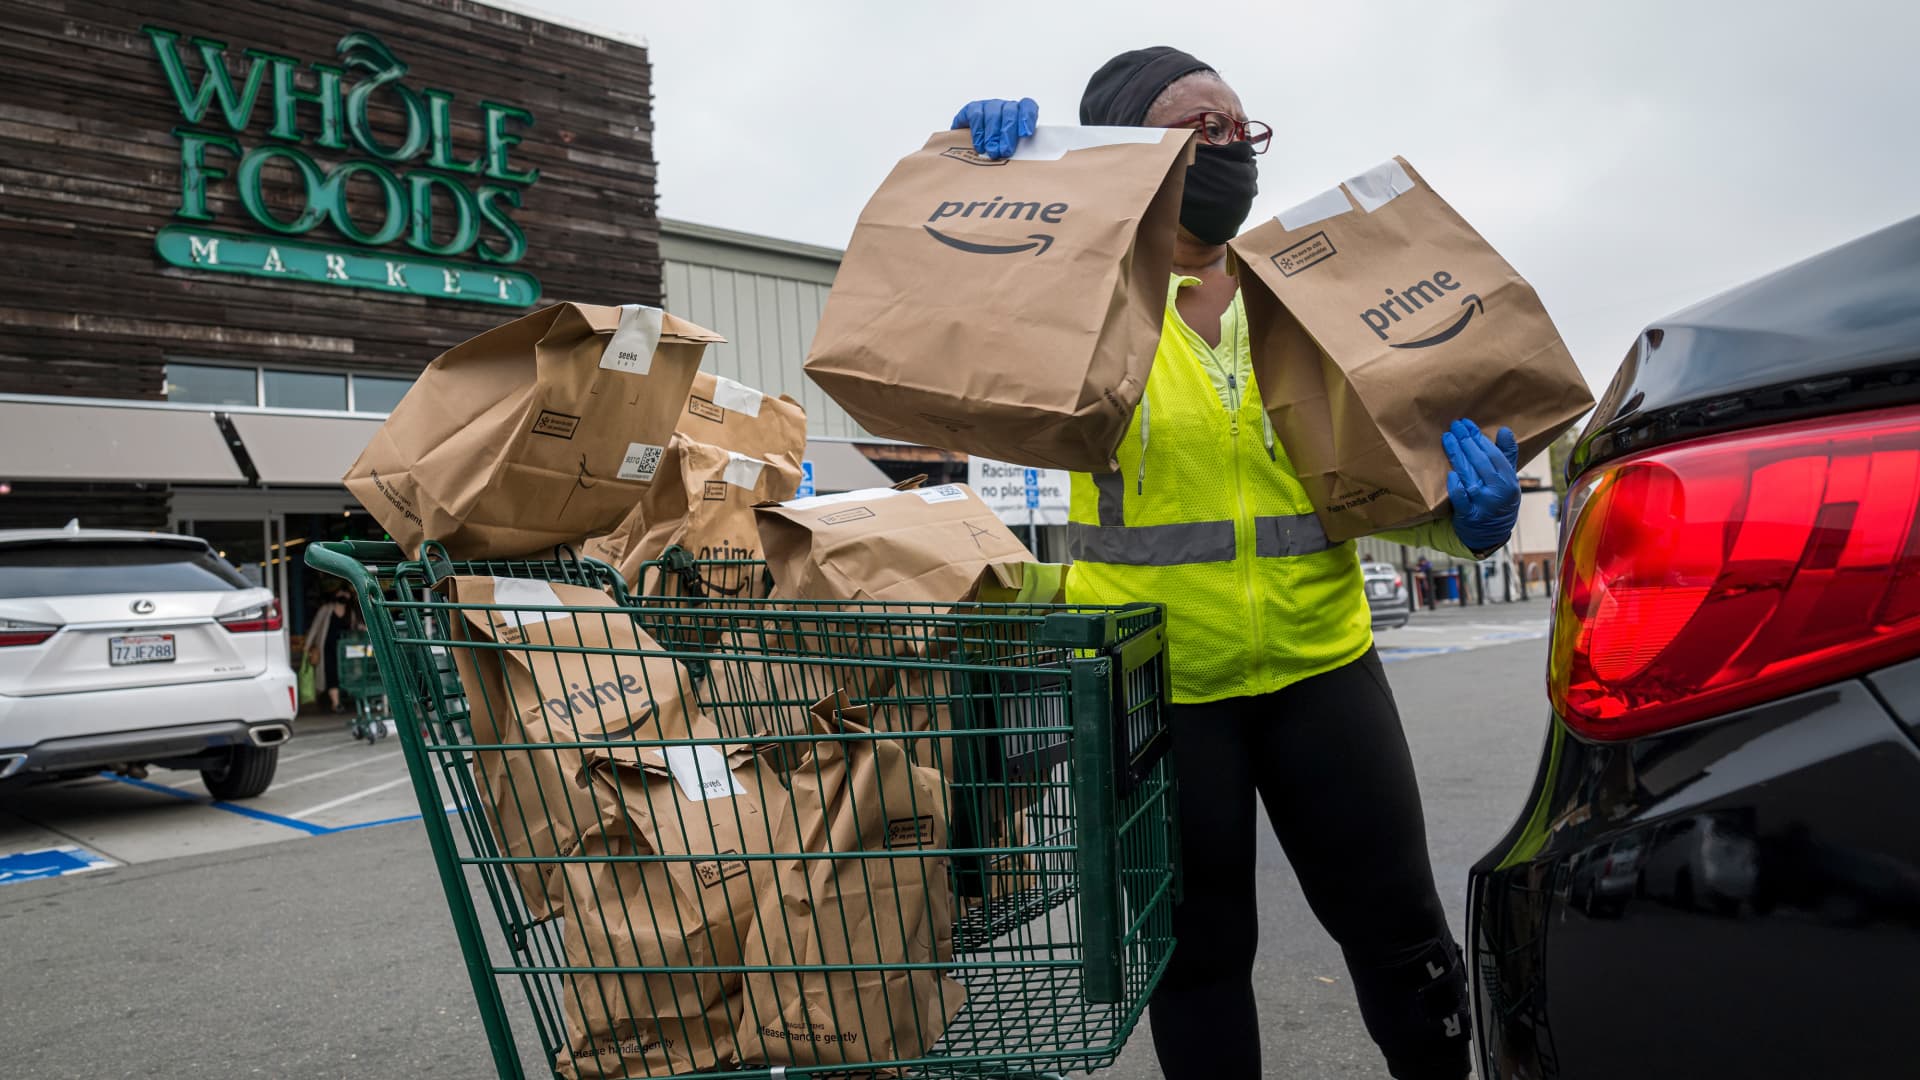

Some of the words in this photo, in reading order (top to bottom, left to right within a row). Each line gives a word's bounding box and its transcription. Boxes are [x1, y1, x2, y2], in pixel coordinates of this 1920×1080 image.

[140, 24, 541, 184] WHOLE
[170, 127, 527, 265] FOODS
[928, 196, 1069, 224] prime
[188, 235, 514, 301] MARKET
[1360, 271, 1462, 341] prime
[982, 486, 997, 497] no
[545, 674, 643, 726] prime
[1426, 961, 1445, 979] L
[1442, 1013, 1461, 1037] R
